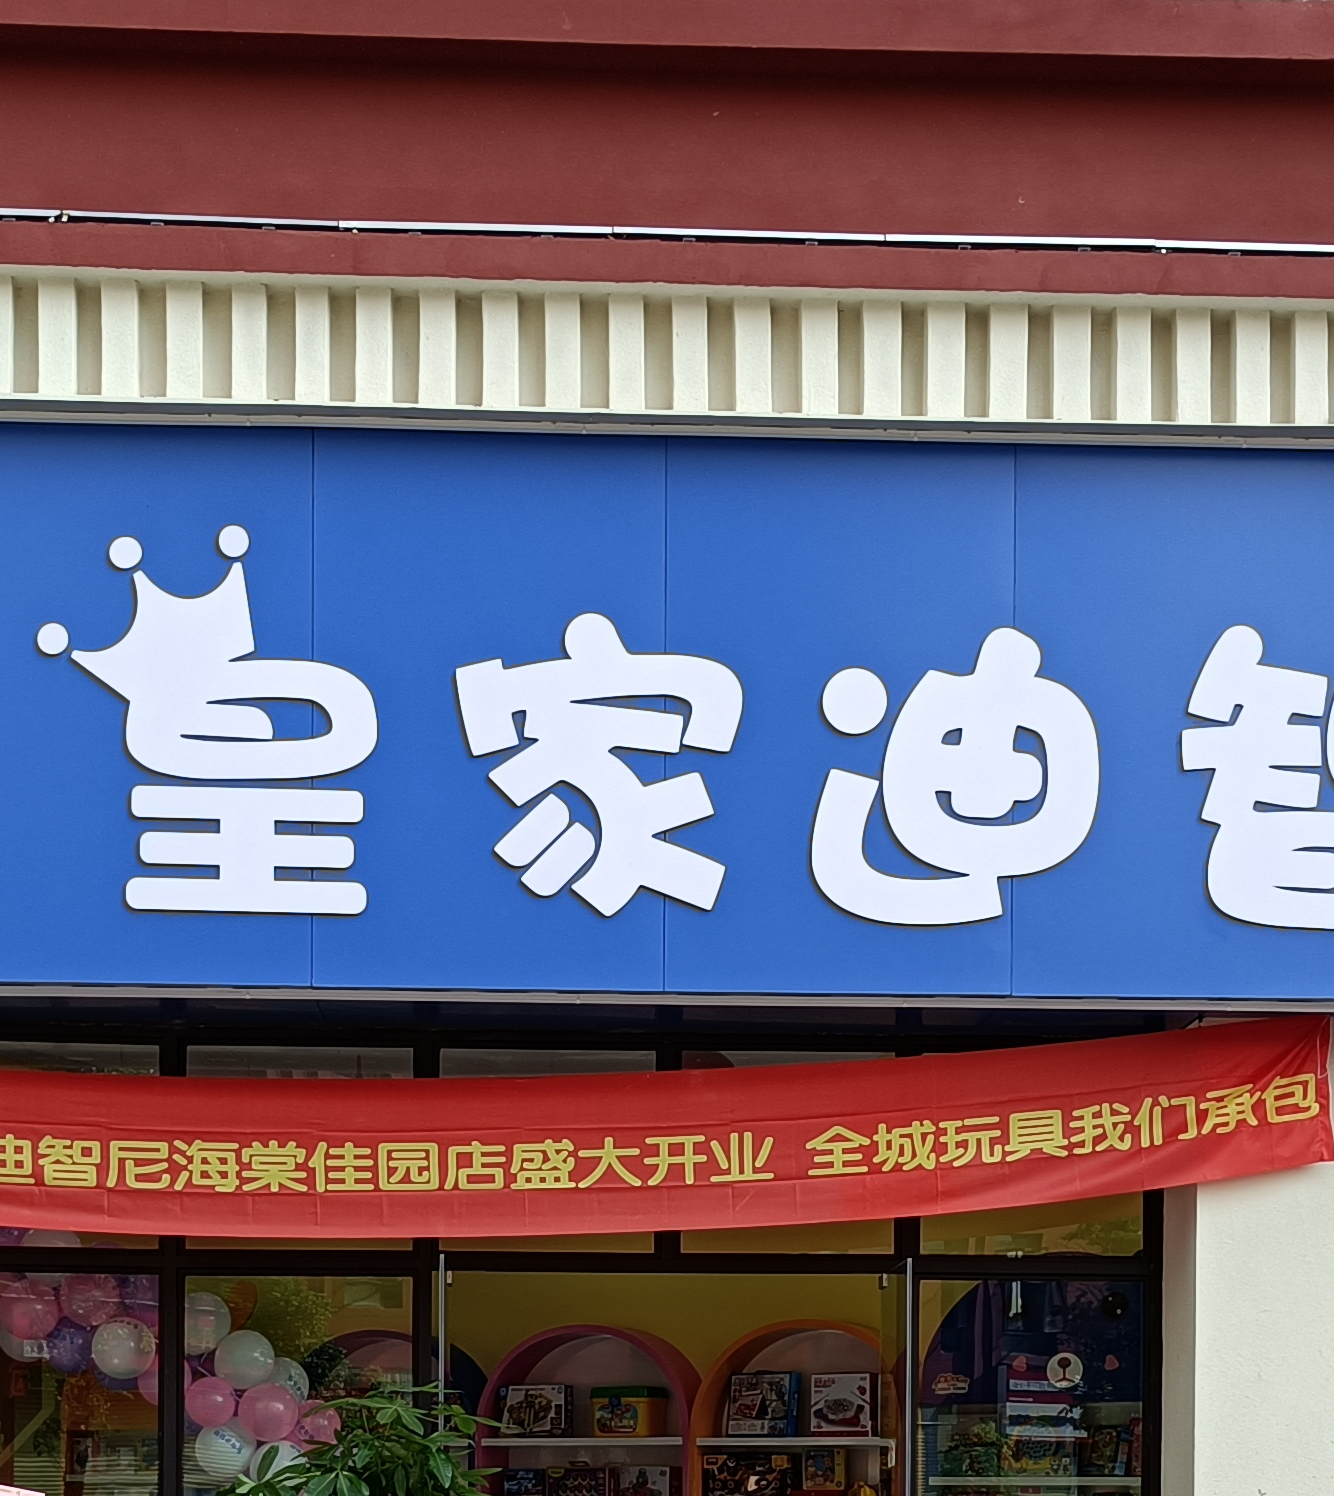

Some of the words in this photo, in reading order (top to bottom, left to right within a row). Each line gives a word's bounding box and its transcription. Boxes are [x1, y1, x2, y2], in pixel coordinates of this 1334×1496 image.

[806, 1073, 1320, 1178] 全城玩具我们承包
